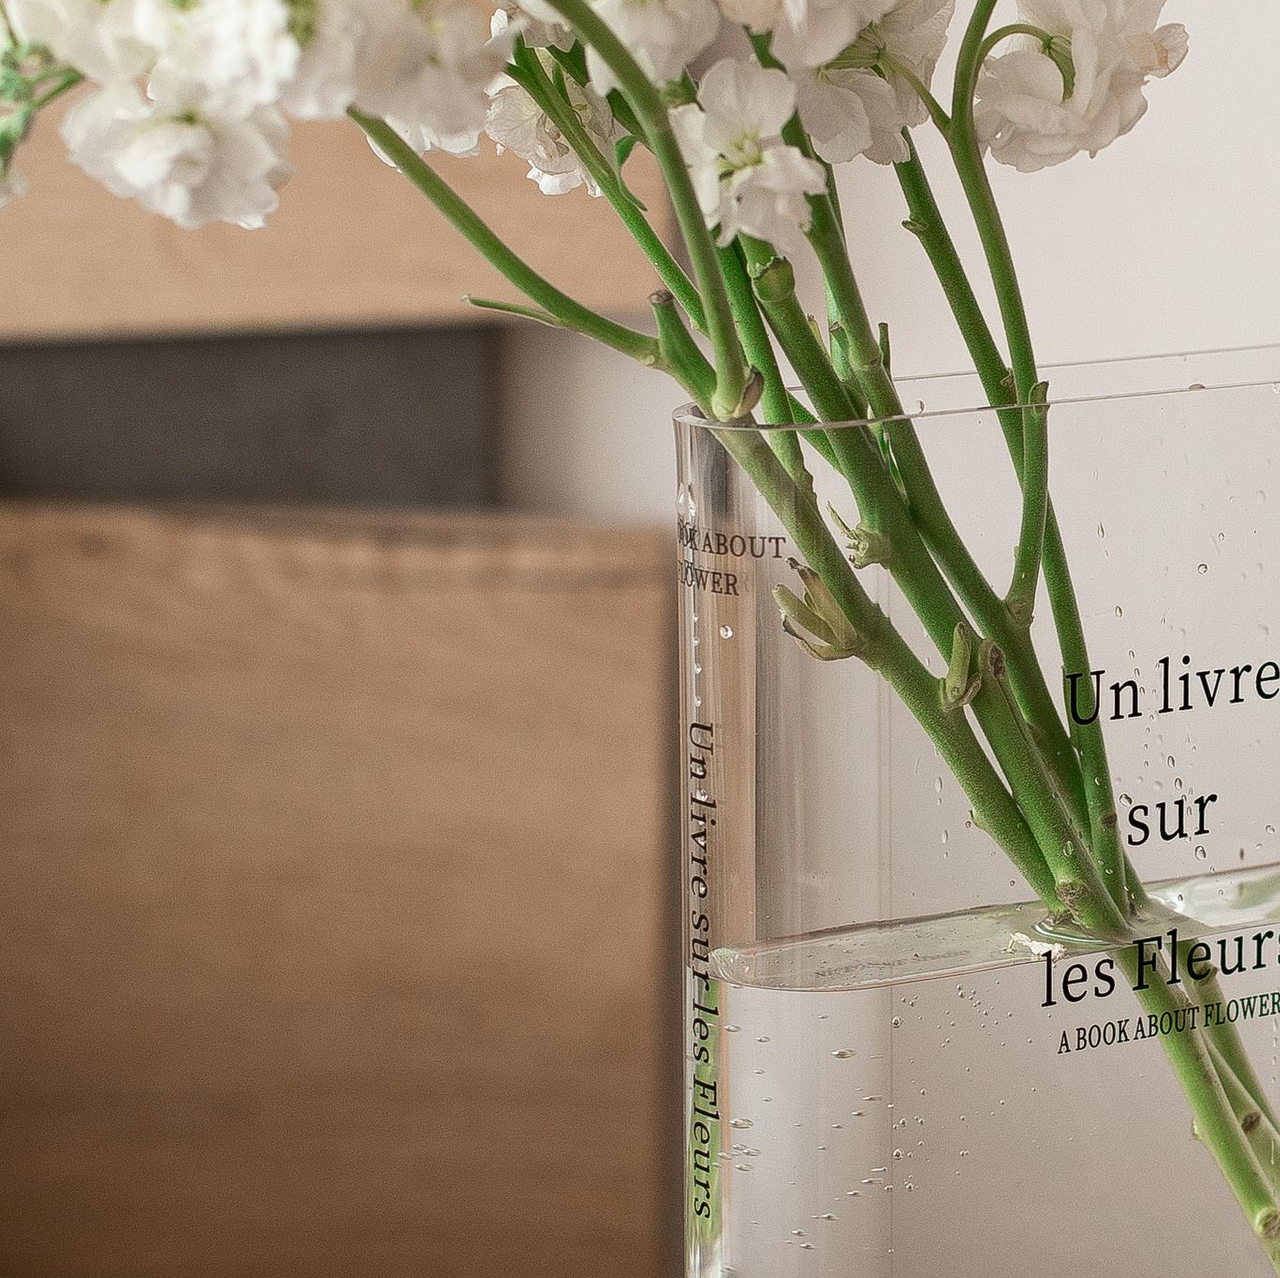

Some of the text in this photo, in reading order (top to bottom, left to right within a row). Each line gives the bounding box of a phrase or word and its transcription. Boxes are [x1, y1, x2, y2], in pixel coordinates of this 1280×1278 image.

[702, 531, 786, 558] ABOUT
[1065, 655, 1280, 725] Un livre
[1127, 793, 1218, 846] sur
[689, 722, 721, 1219] Un livre sur les Fleurs
[1041, 949, 1116, 1007] les
[1057, 1030, 1071, 1054] A
[1075, 1018, 1130, 1051] BOOK
[1133, 1006, 1200, 1040] ABOUT
